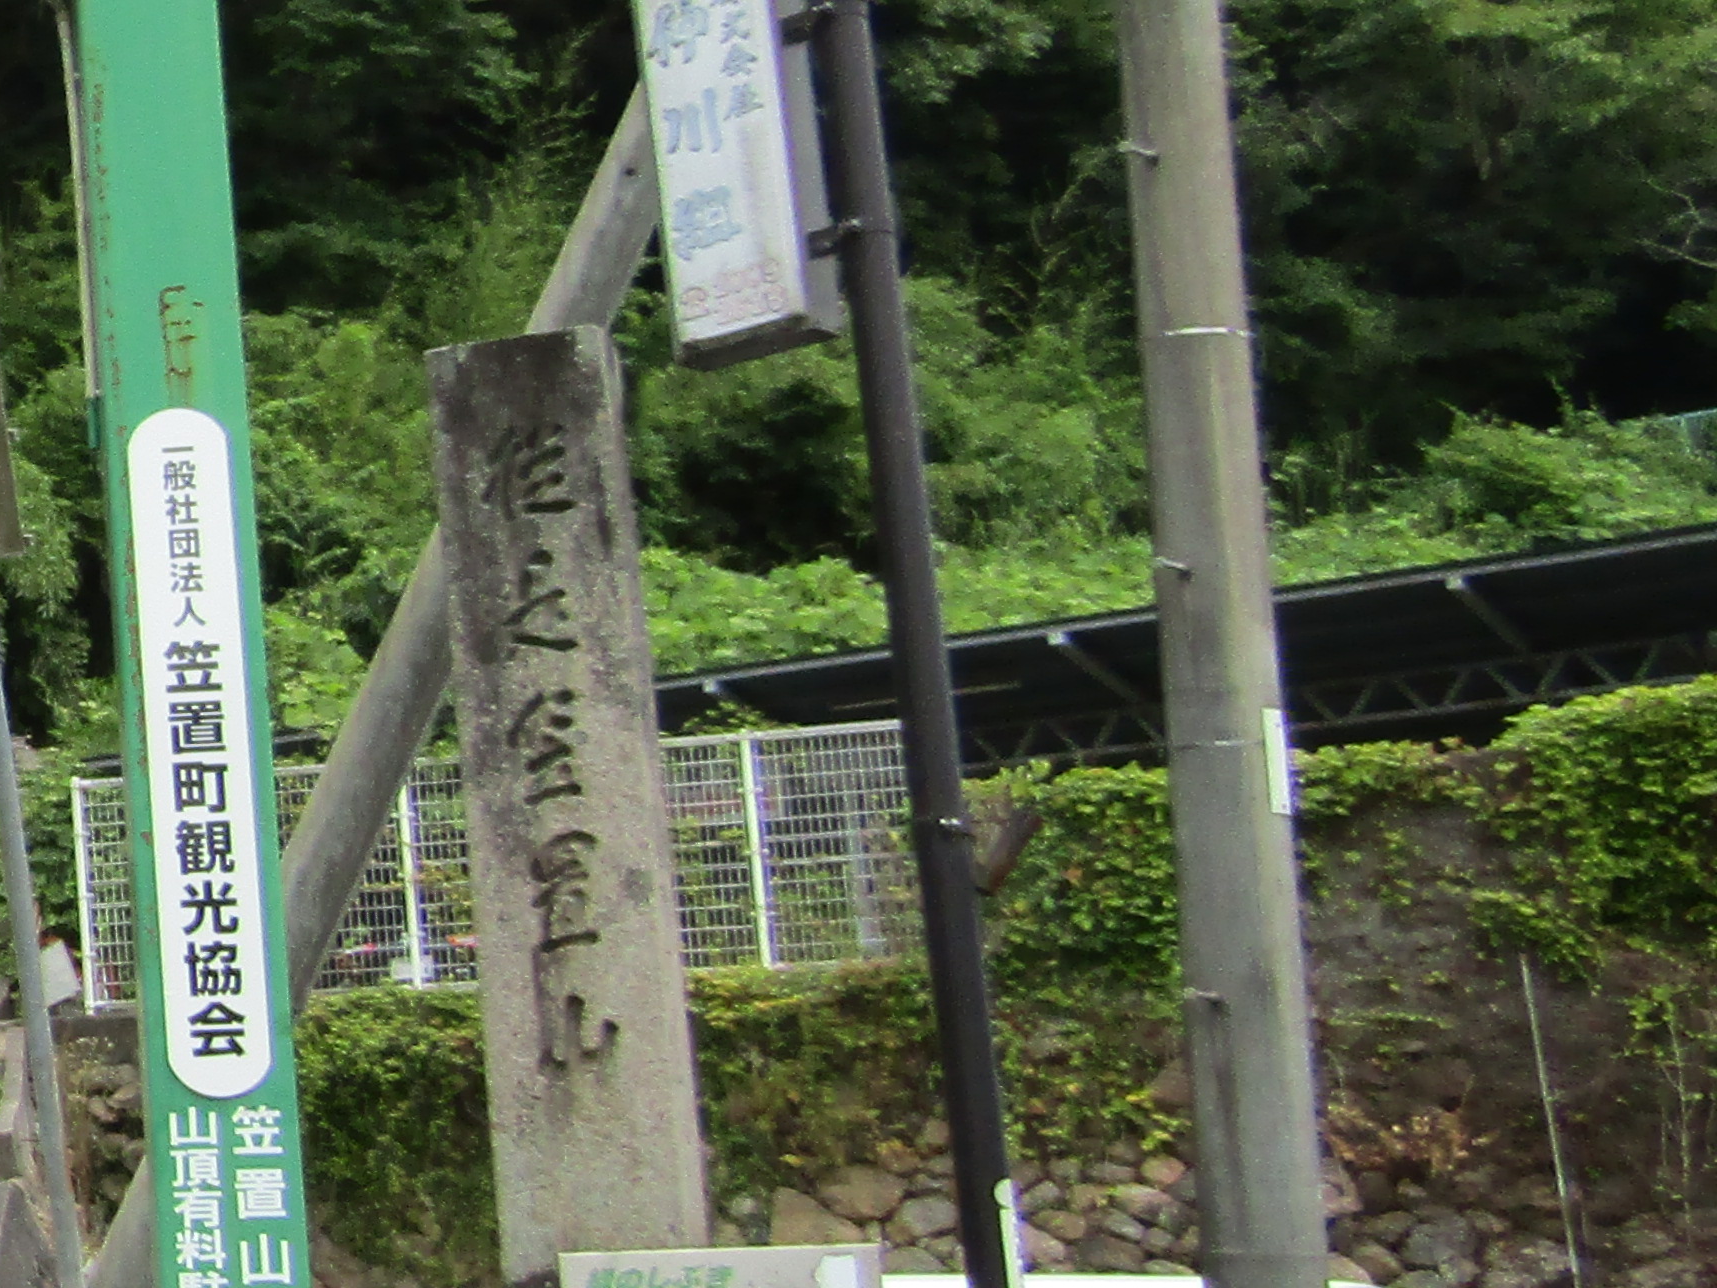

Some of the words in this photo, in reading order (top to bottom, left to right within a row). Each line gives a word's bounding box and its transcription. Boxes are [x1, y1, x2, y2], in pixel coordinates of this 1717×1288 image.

[162, 445, 207, 628] 一般社団法人
[164, 640, 246, 1059] 笠置町観光協会
